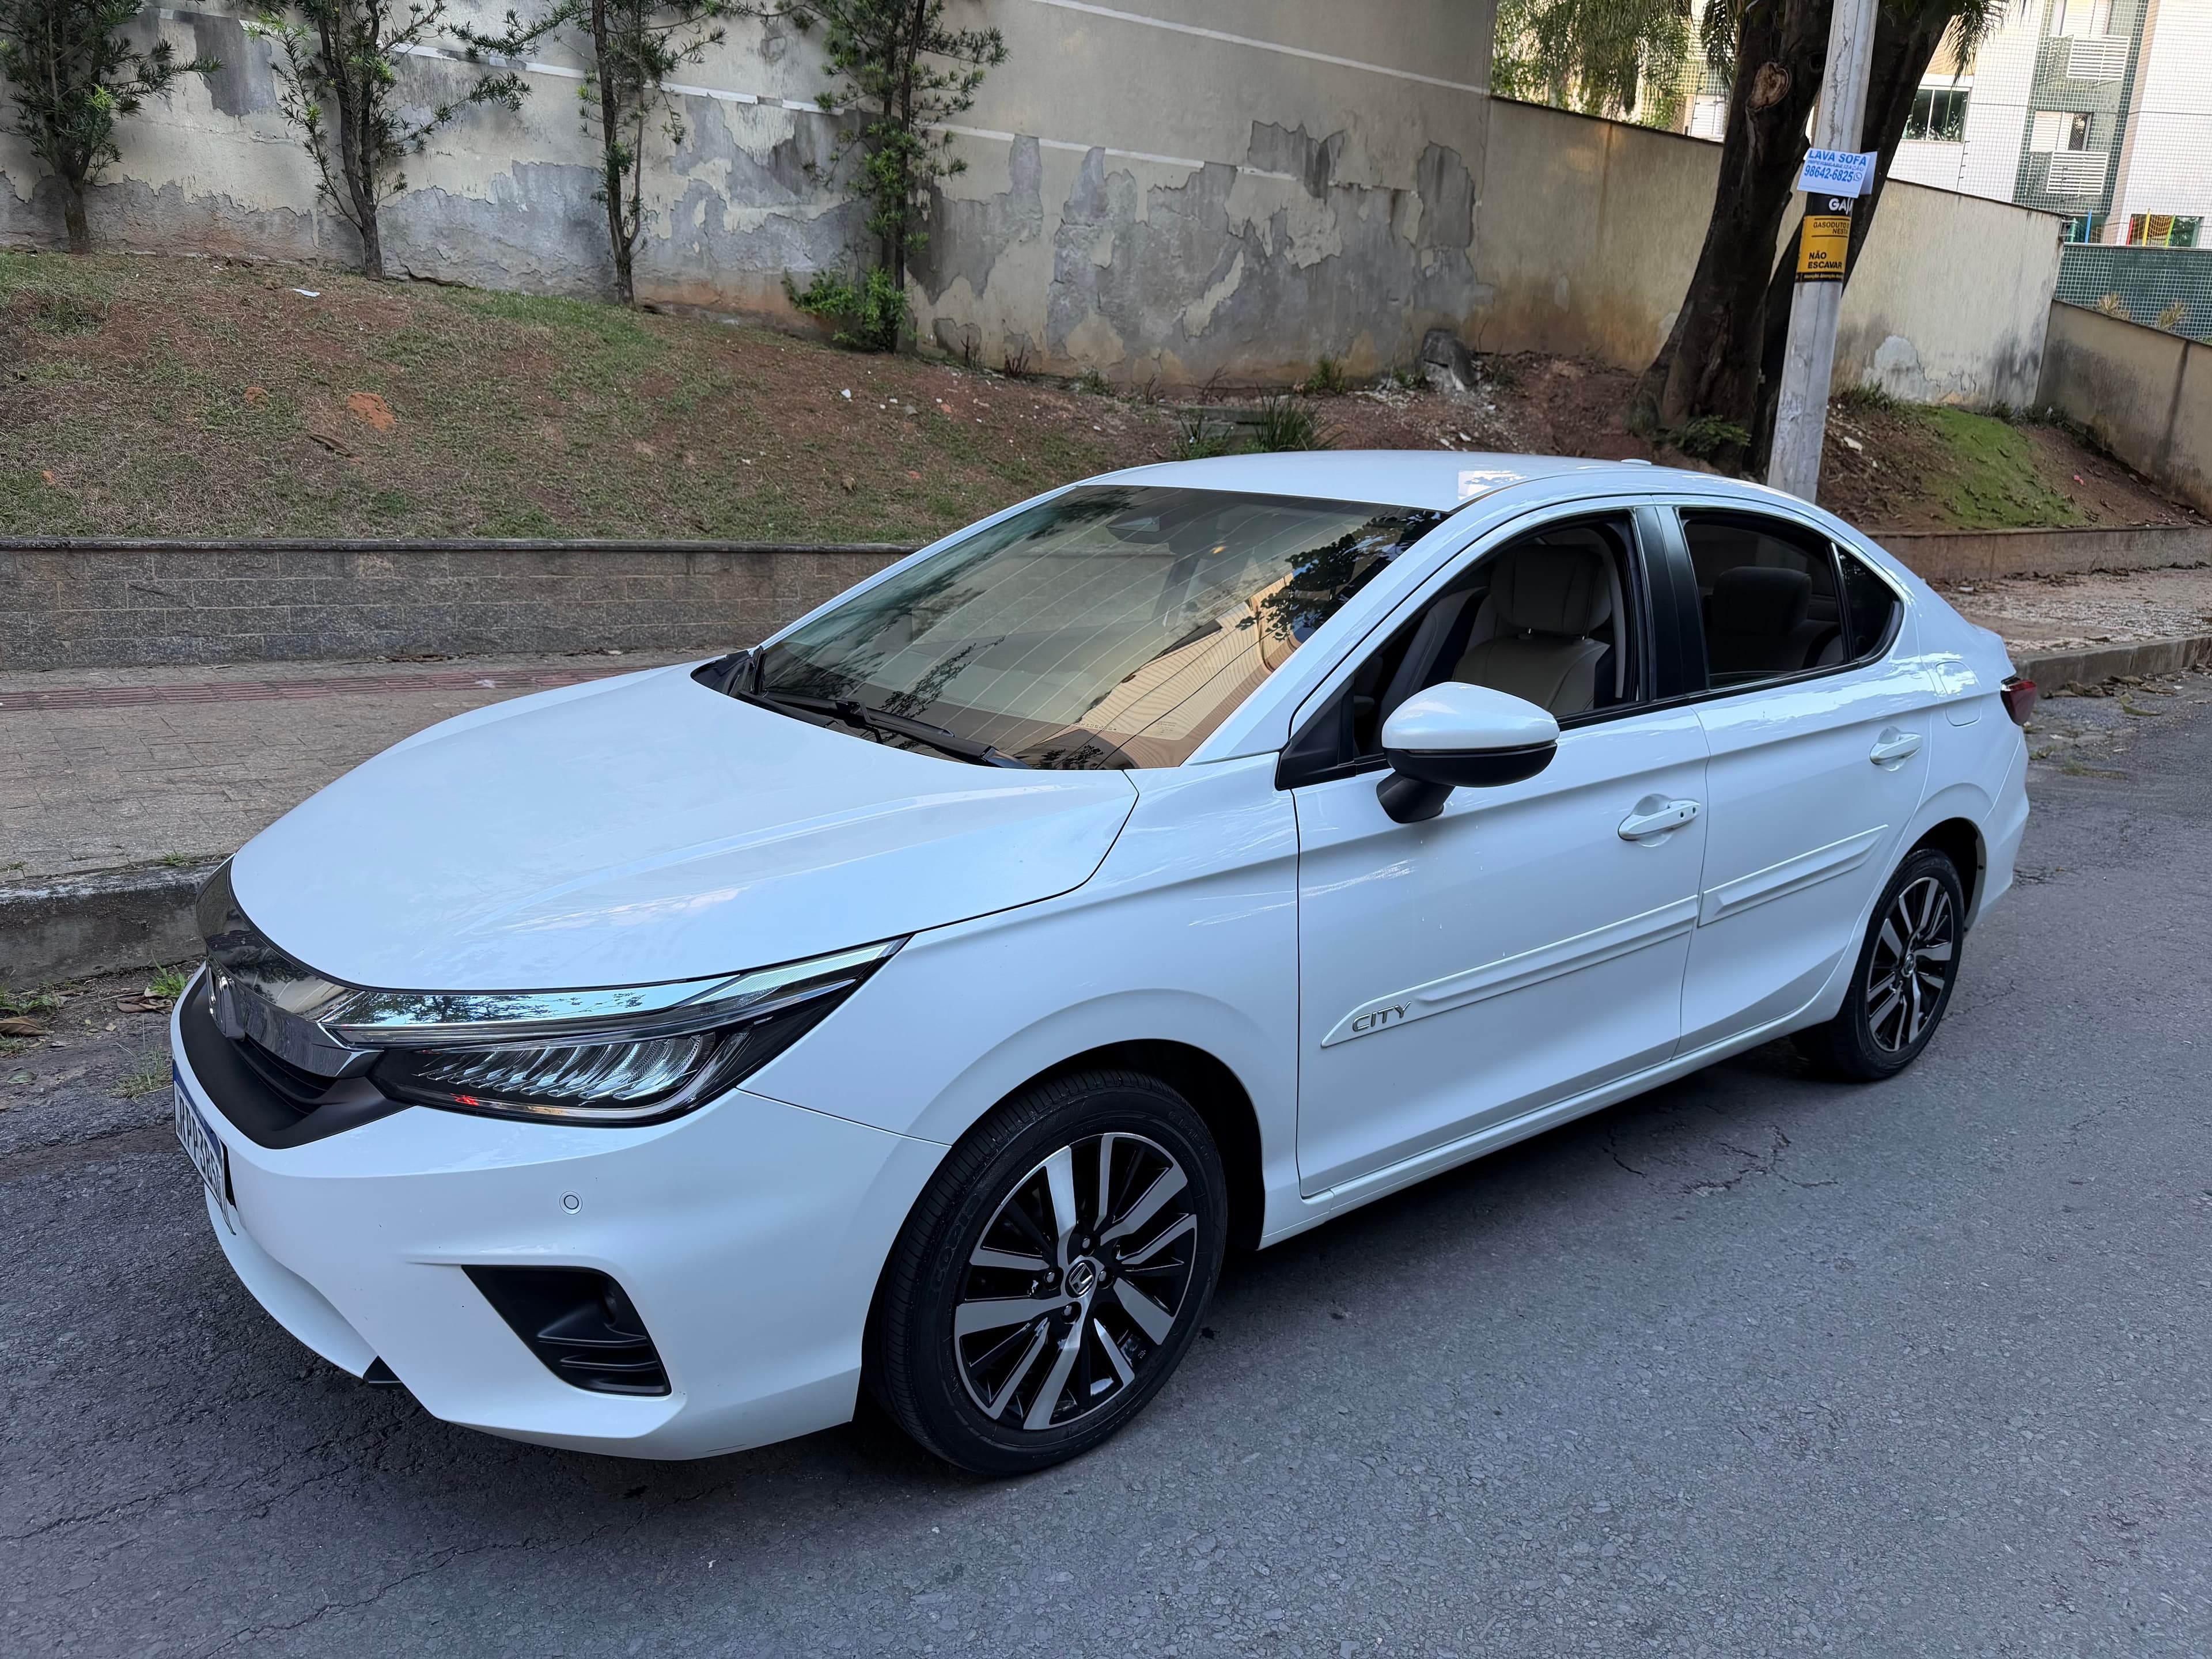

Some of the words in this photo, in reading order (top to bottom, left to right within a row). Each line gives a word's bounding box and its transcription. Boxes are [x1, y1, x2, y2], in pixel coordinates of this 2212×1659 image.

[1808, 150, 1835, 162] LAVA
[1838, 153, 1867, 166] SOFA
[1804, 165, 1854, 183] 98642-6825
[1813, 221, 1847, 229] GASODUTO
[1809, 250, 1827, 260] NÃO
[1808, 261, 1843, 270] ESCAVAR
[1352, 1001, 1412, 1032] CITY
